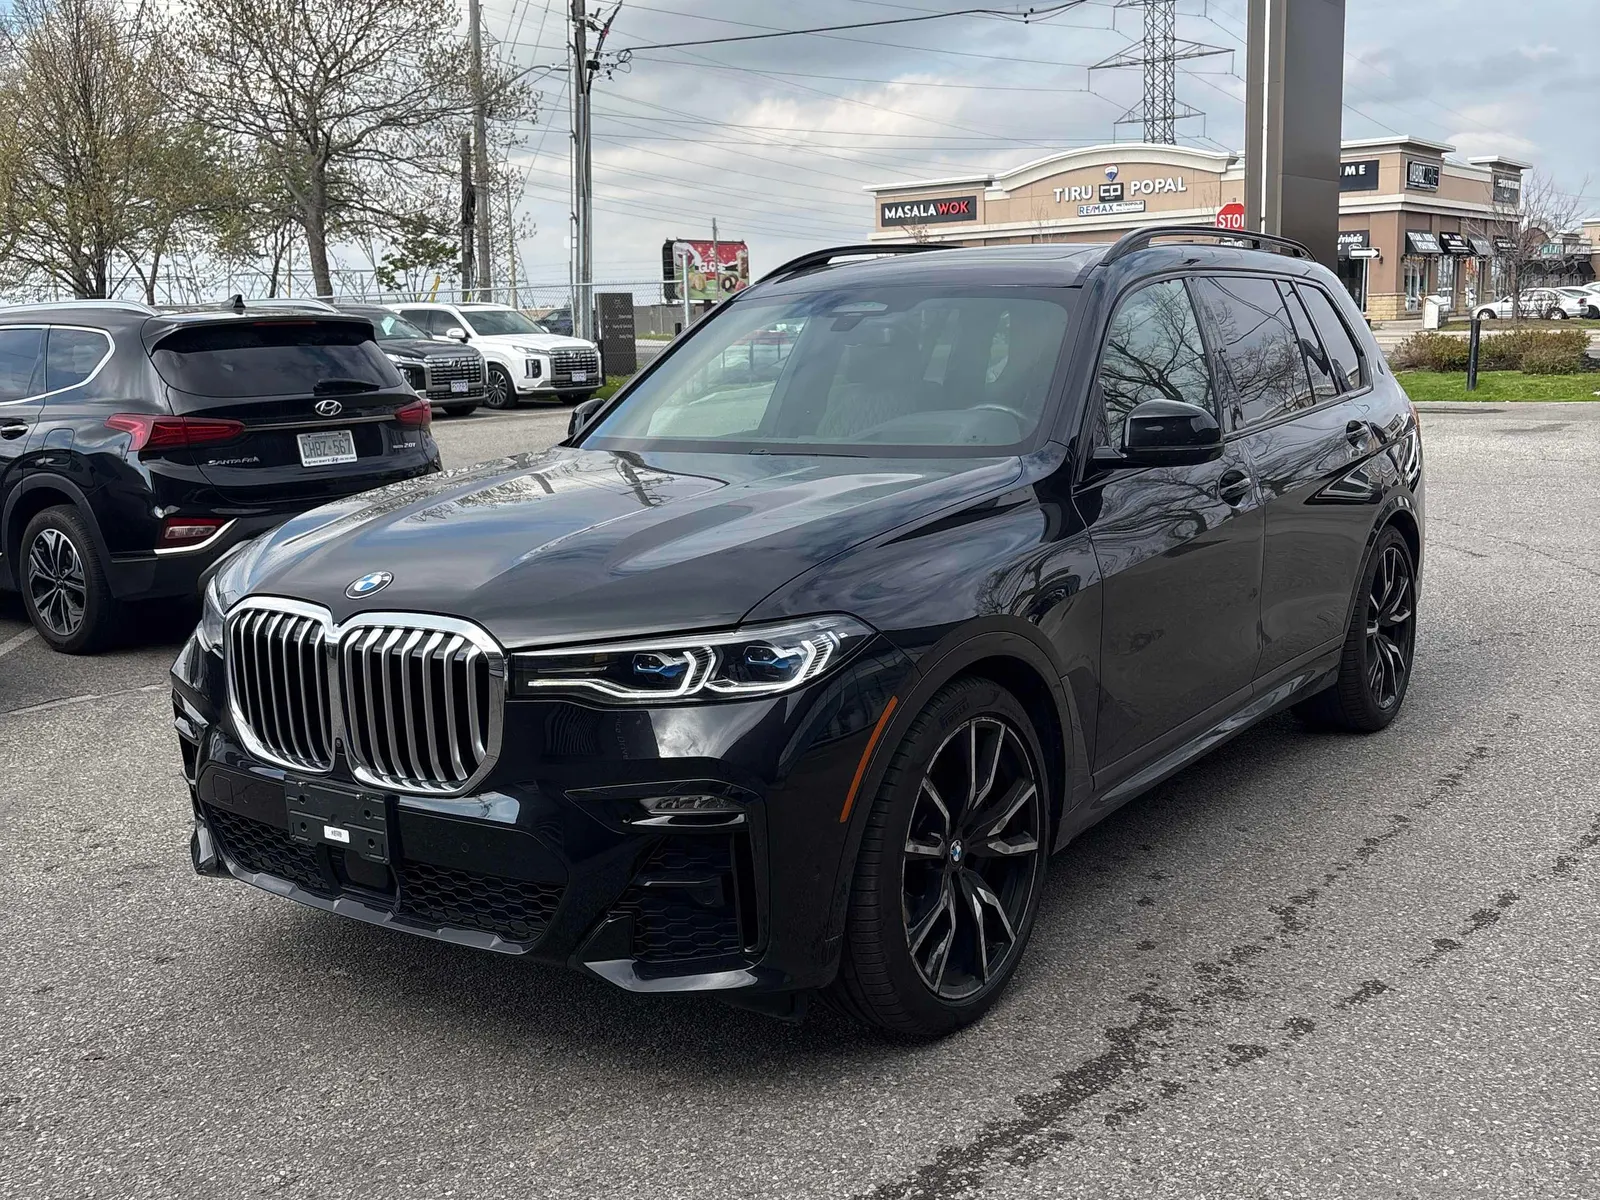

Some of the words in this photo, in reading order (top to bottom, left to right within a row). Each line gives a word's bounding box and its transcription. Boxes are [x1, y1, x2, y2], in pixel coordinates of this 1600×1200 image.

[1053, 184, 1093, 203] TIRU
[1130, 176, 1187, 196] POPAL
[884, 204, 937, 220] MASALA
[937, 200, 969, 215] WOK
[1079, 204, 1114, 215] RE/MAX
[302, 441, 329, 459] CHBZ
[332, 438, 353, 455] 567
